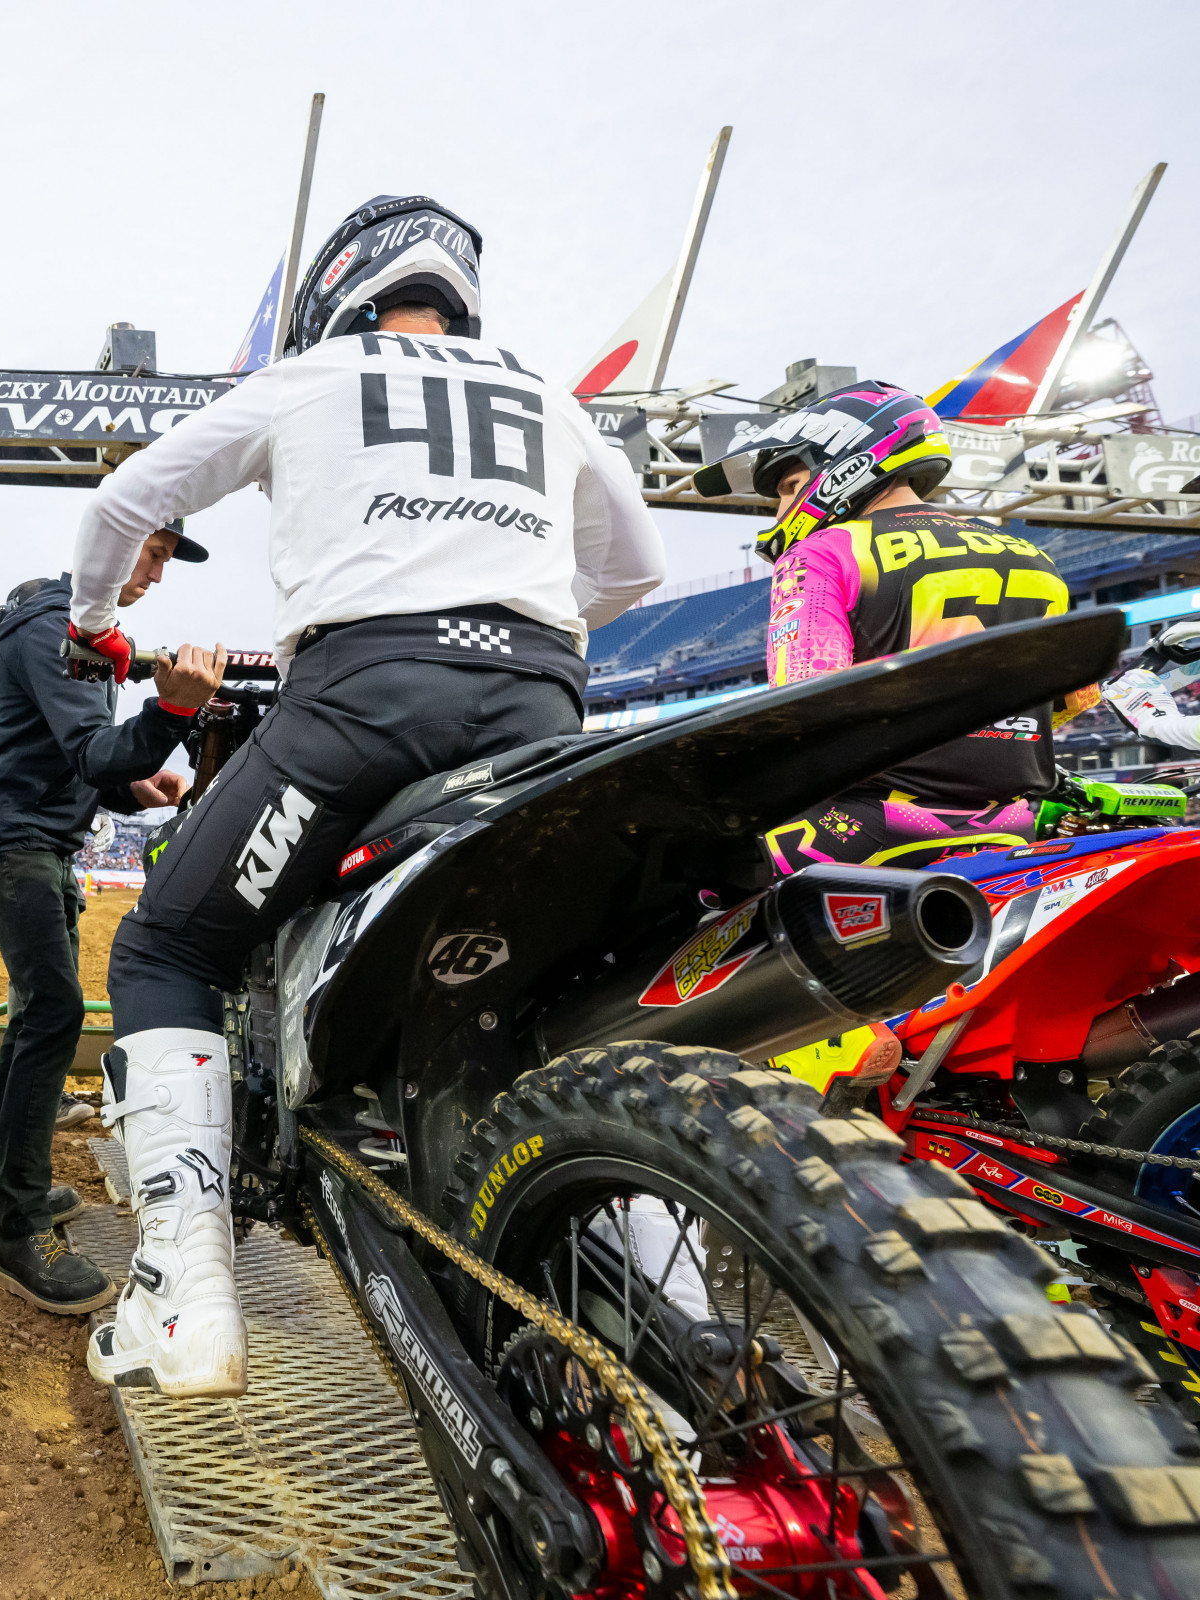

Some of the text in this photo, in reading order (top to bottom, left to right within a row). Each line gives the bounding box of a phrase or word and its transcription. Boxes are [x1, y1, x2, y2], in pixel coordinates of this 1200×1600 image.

[371, 216, 469, 258] JUSTIN
[324, 248, 356, 288] BELL
[56, 379, 216, 406] MOUNTAIN
[360, 372, 546, 497] 46
[826, 456, 867, 495] Arai
[951, 454, 1006, 482] C
[363, 492, 553, 541] FASTHOUSE
[875, 529, 1055, 573] BLOS
[771, 620, 799, 641] LIQUI
[772, 630, 799, 653] MOLY
[1122, 798, 1182, 808] RENTHAL
[235, 784, 319, 910] KTM
[341, 848, 366, 873] MOTUL
[1041, 878, 1076, 898] AMA
[428, 935, 504, 976] 46
[676, 924, 719, 980] PRO
[678, 913, 757, 999] CIRCUIT
[929, 1139, 952, 1158] TM
[471, 1134, 544, 1232] DUNLOP
[977, 1162, 1004, 1180] Kite
[406, 1356, 475, 1463] CHAINWHEELS
